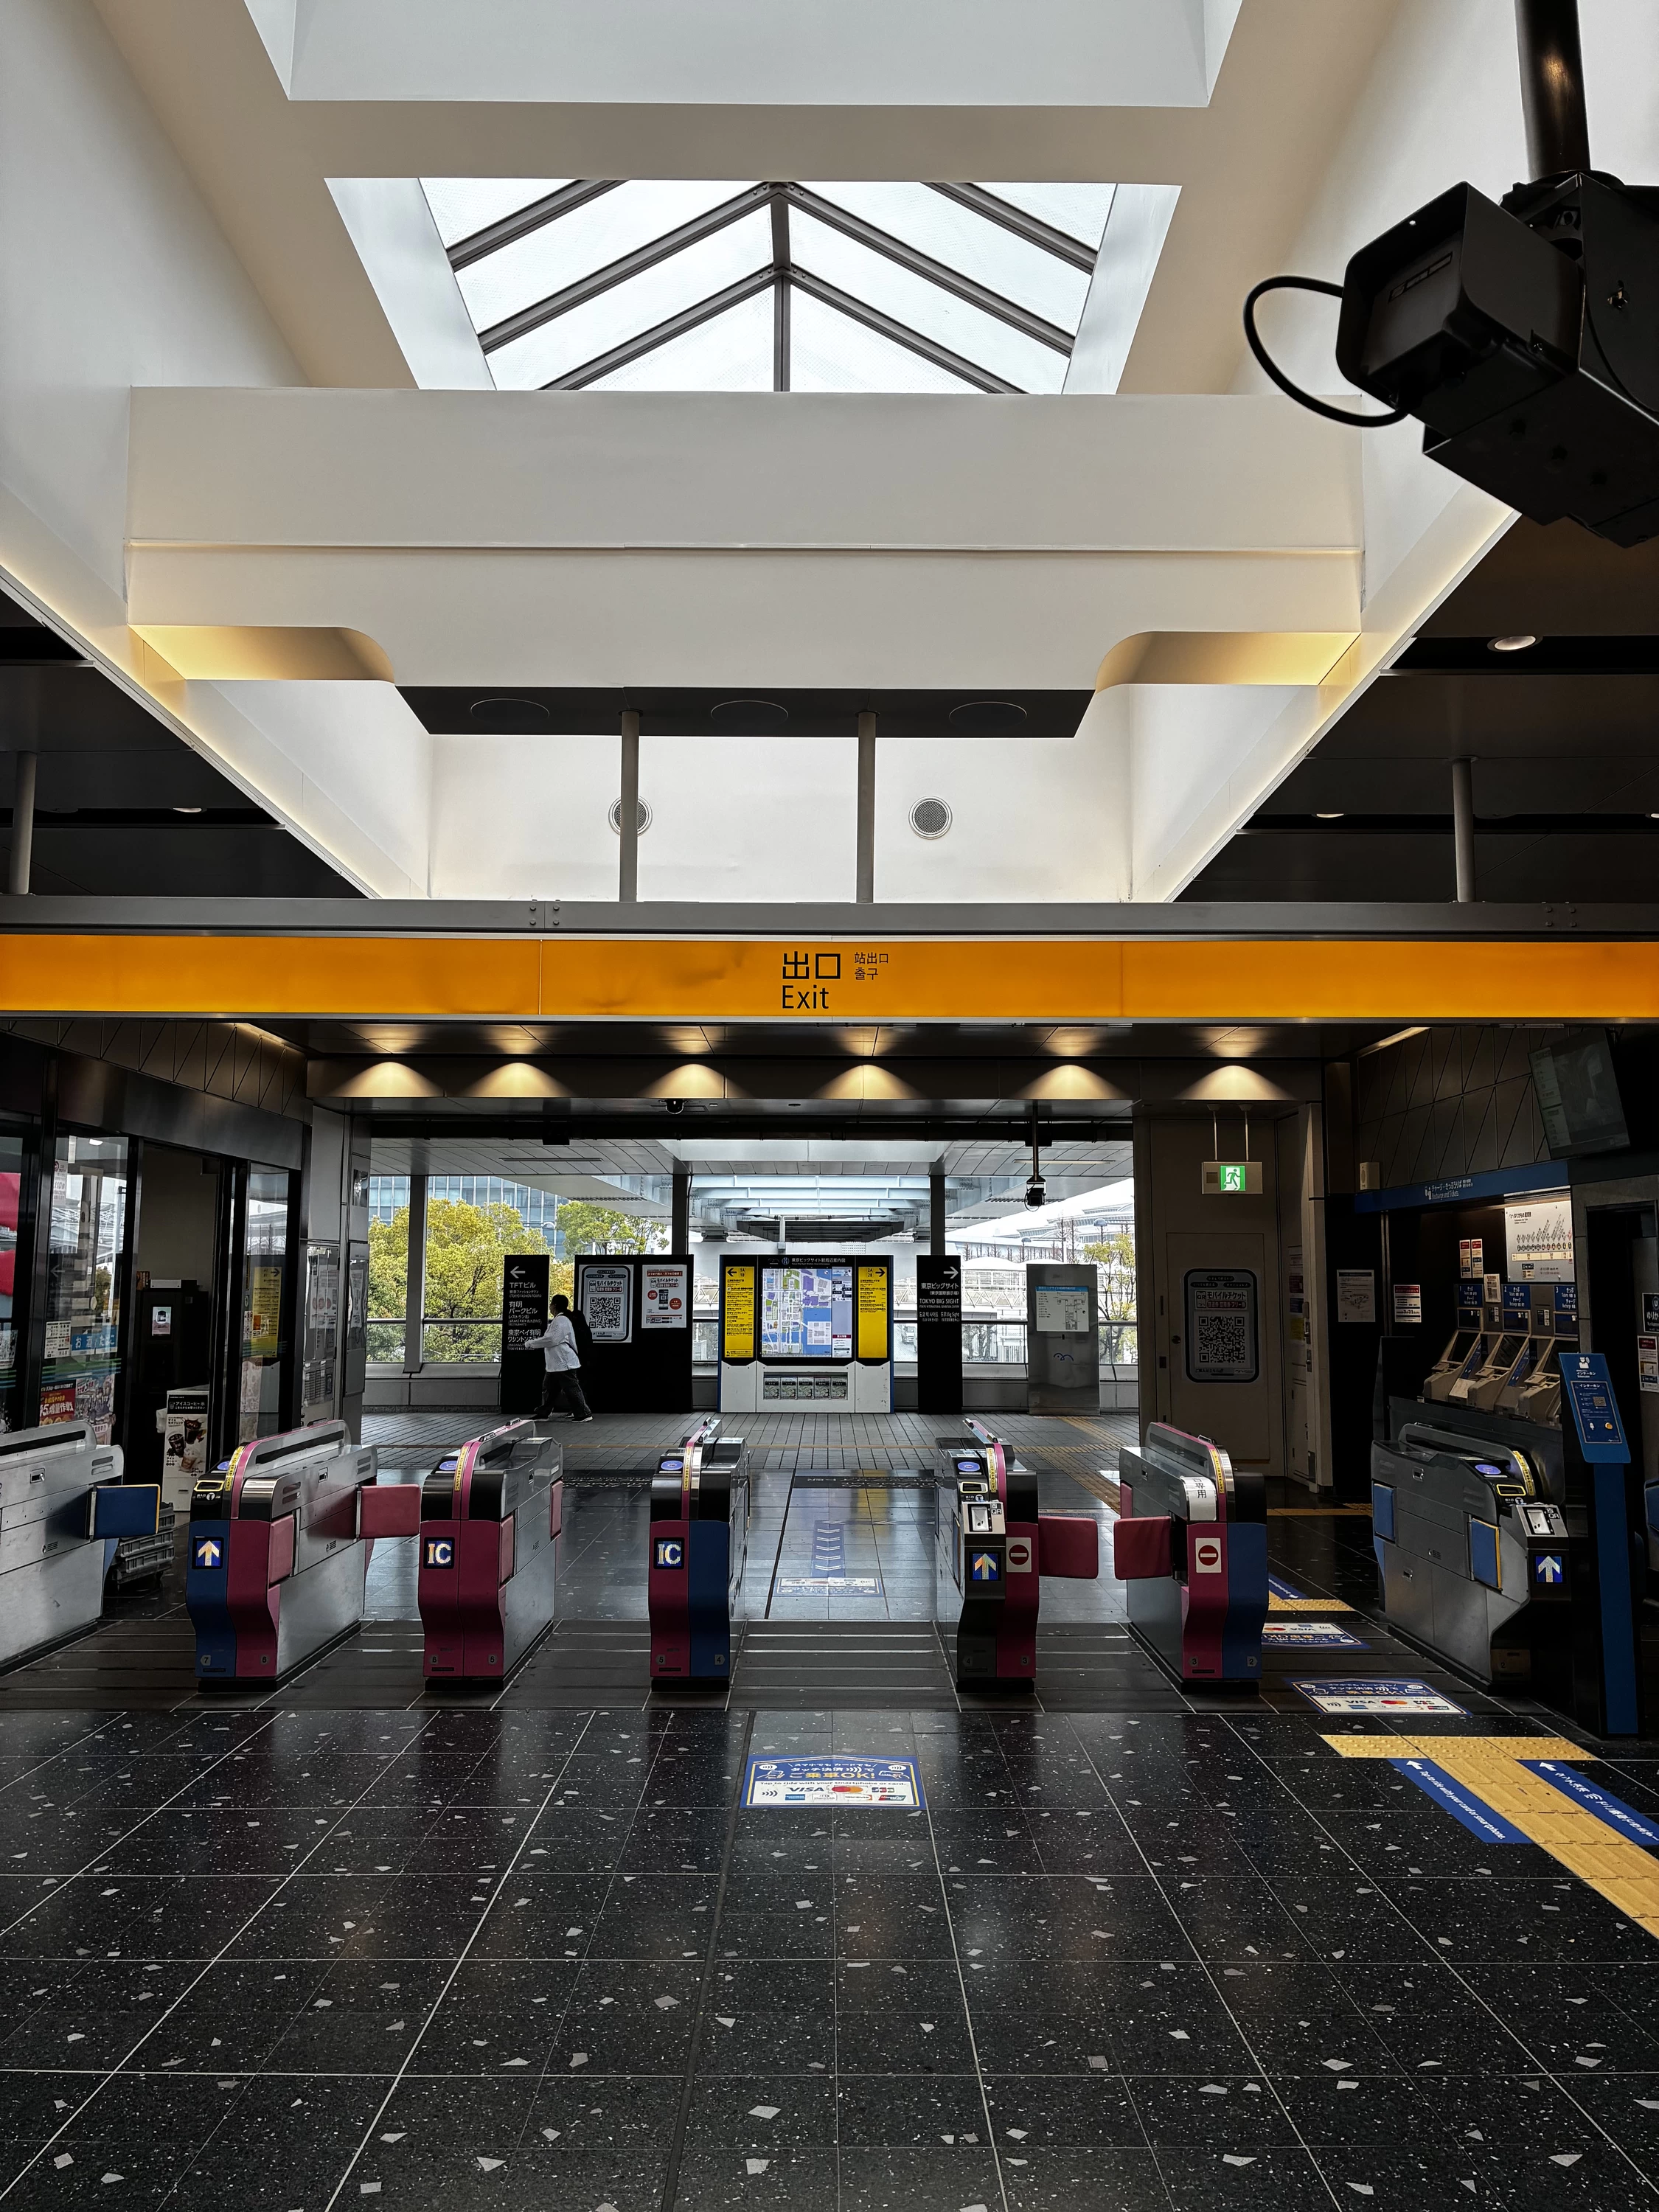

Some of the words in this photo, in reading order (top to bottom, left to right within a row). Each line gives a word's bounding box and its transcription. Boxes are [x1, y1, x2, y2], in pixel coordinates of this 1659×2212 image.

[782, 950, 841, 980] 出口
[854, 951, 889, 964] 站出口
[854, 967, 879, 981] 출구
[782, 984, 830, 1009] Exit
[1208, 1291, 1246, 1300] モバイルチケット
[1646, 1311, 1659, 1321] ゆりか
[428, 1543, 451, 1564] IC
[658, 1543, 681, 1565] IC
[1475, 1815, 1507, 1839] smartphone.
